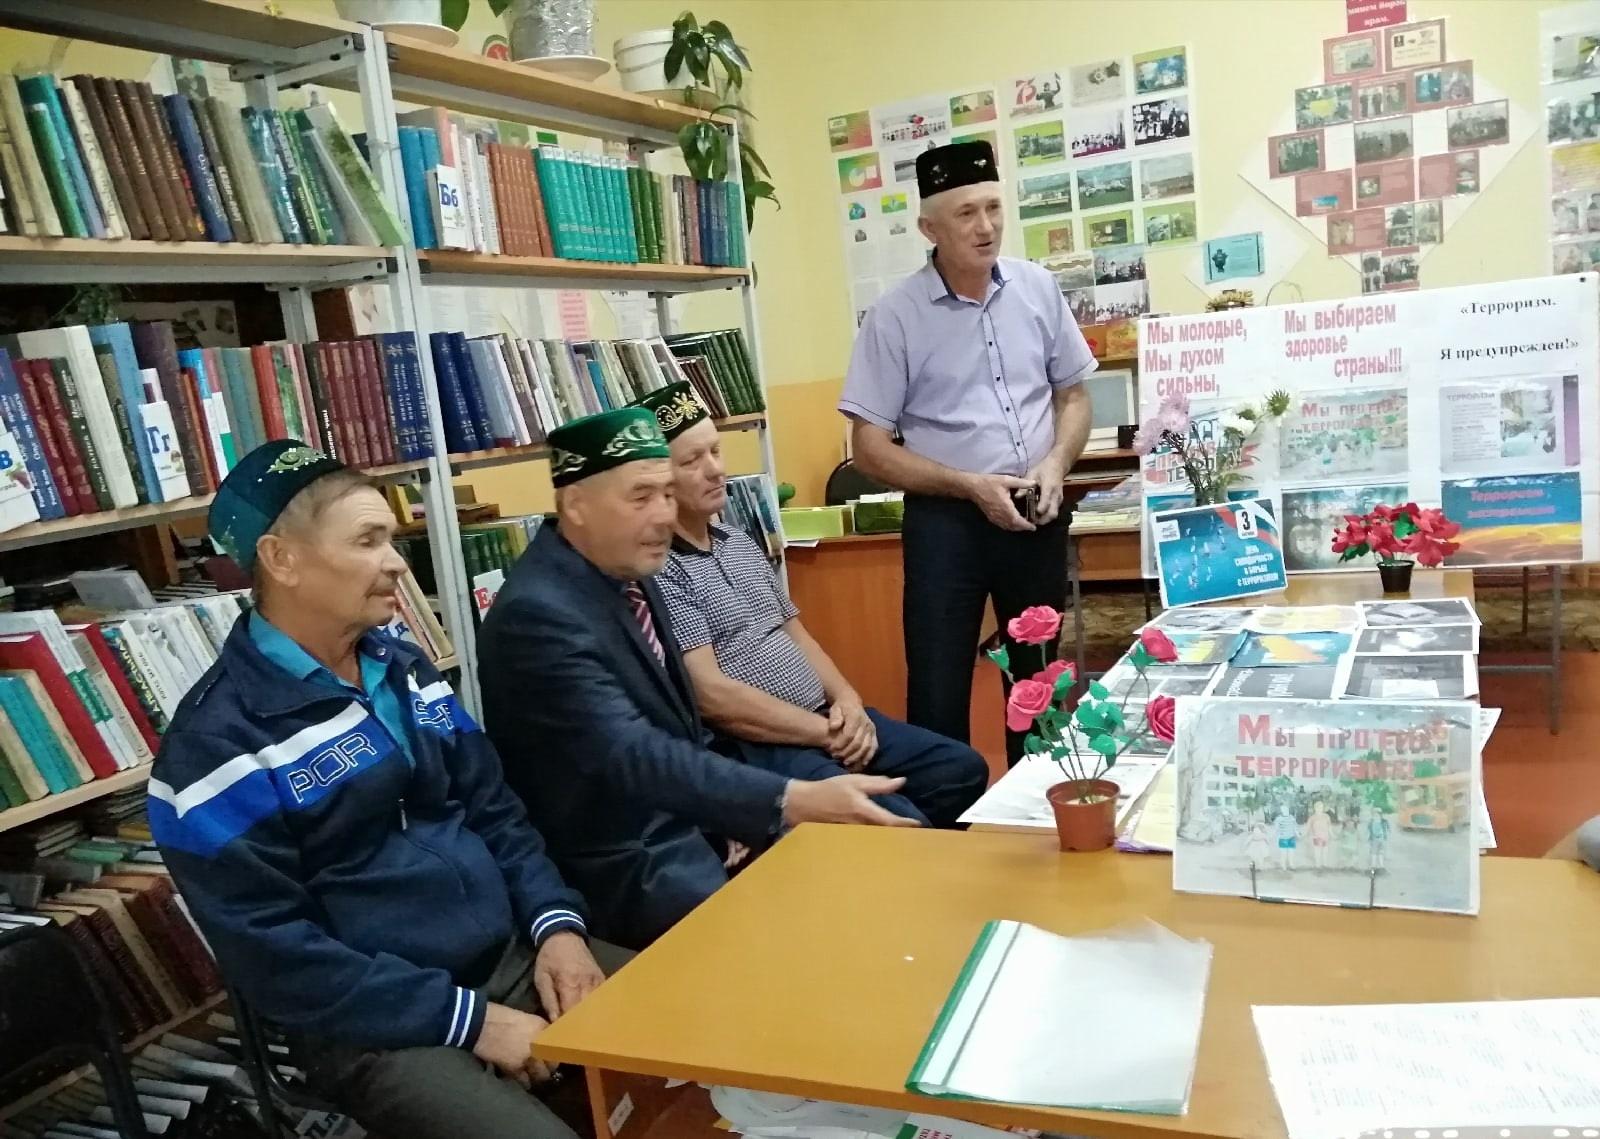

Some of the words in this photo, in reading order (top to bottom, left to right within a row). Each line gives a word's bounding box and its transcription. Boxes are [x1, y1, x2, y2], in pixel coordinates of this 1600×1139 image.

[439, 183, 459, 207] Бб
[1147, 321, 1173, 344] Мы
[1180, 317, 1247, 343] молодые,
[1284, 310, 1306, 333] Мы
[1315, 303, 1396, 332] выбираем
[1145, 348, 1172, 373] Мы
[1180, 346, 1224, 375] духом
[1285, 333, 1348, 361] здоровье
[1440, 348, 1451, 360] Я
[1334, 348, 1402, 381] страны!!!
[1157, 373, 1220, 396] сильны,
[1302, 402, 1329, 418] Мы
[1241, 511, 1251, 531] 3
[1237, 713, 1296, 748] Мы
